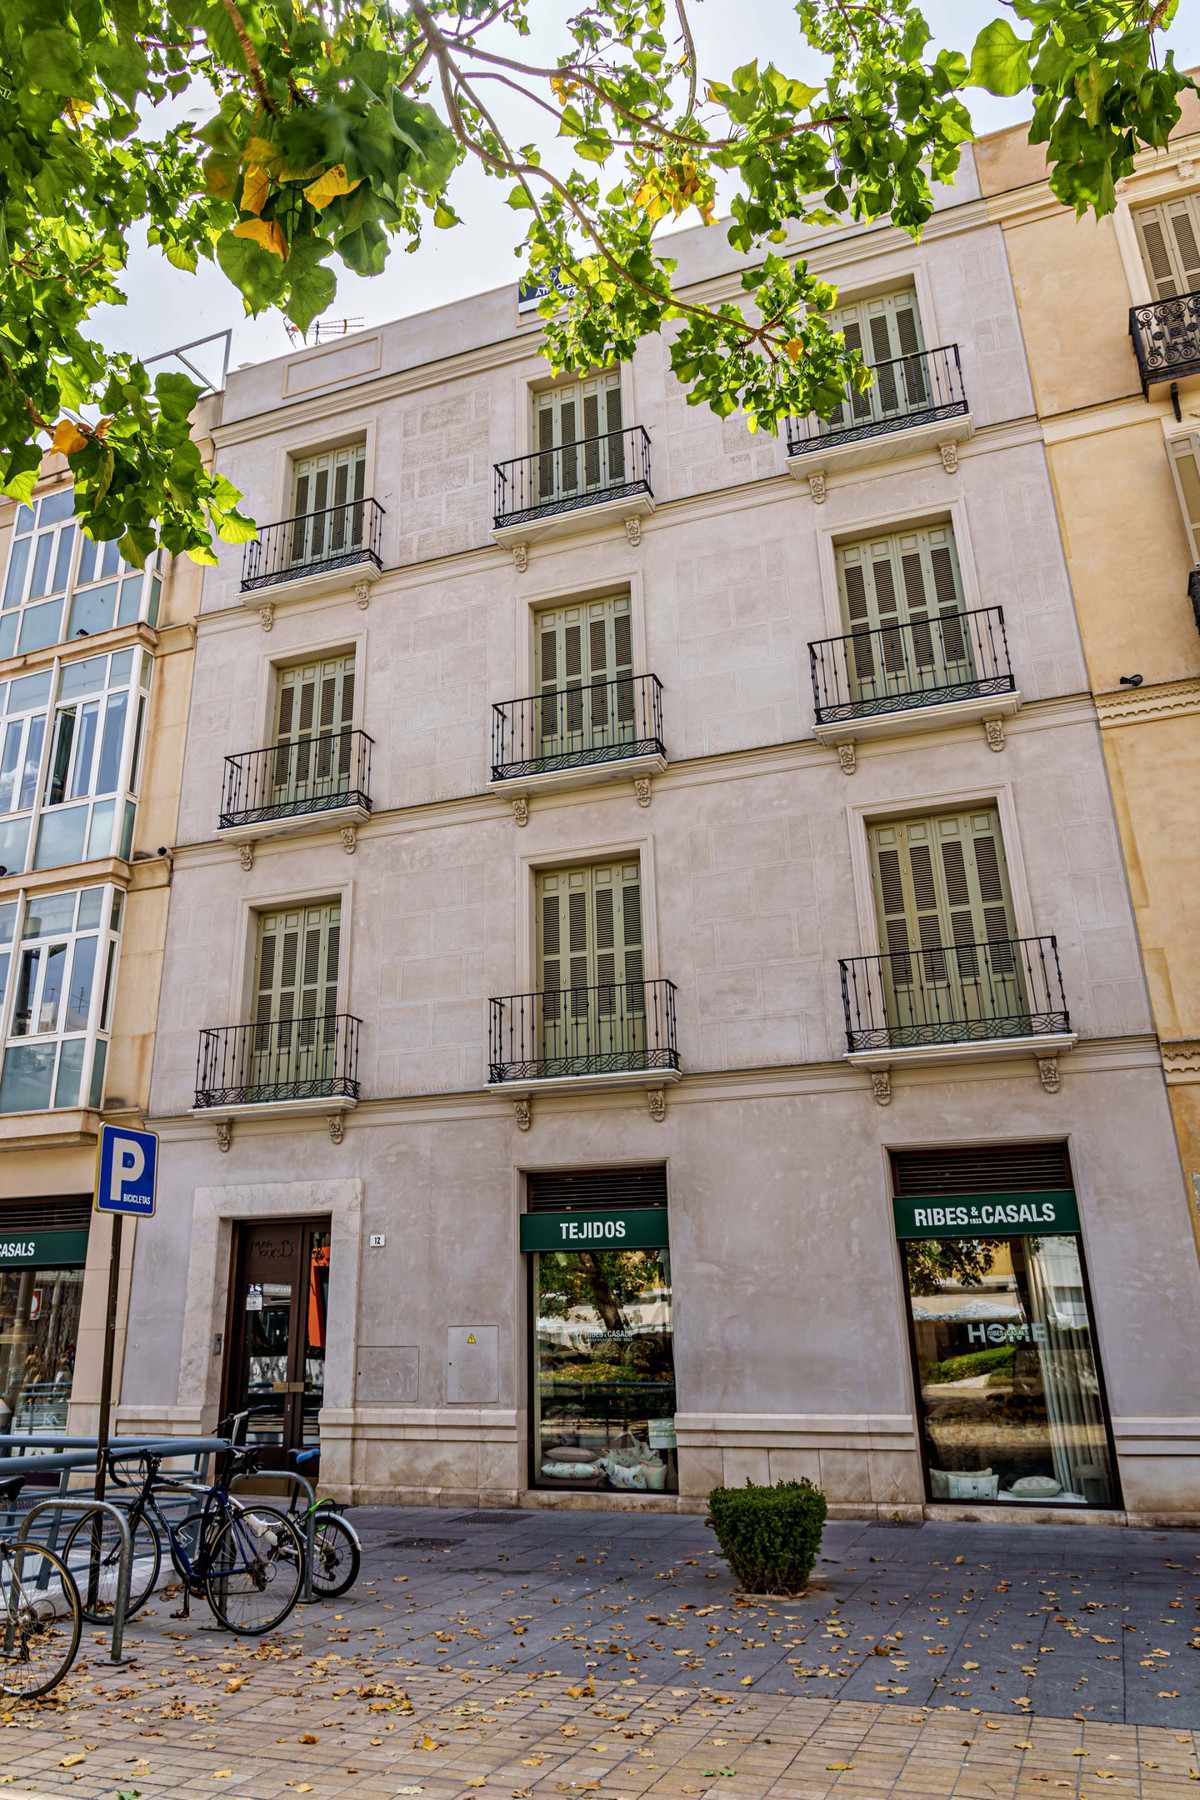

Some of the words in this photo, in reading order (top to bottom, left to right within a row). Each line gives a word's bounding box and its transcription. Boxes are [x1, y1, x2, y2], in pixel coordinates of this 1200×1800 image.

[110, 1137, 145, 1201] P
[123, 1193, 151, 1205] BICICLETAS
[914, 1207, 969, 1226] RIBES
[970, 1206, 979, 1216] &
[981, 1203, 1056, 1223] CASALS
[560, 1221, 626, 1239] TEJIDOS
[374, 1236, 381, 1245] 12
[0, 1242, 35, 1258] ASALS
[967, 1322, 1048, 1343] HOME
